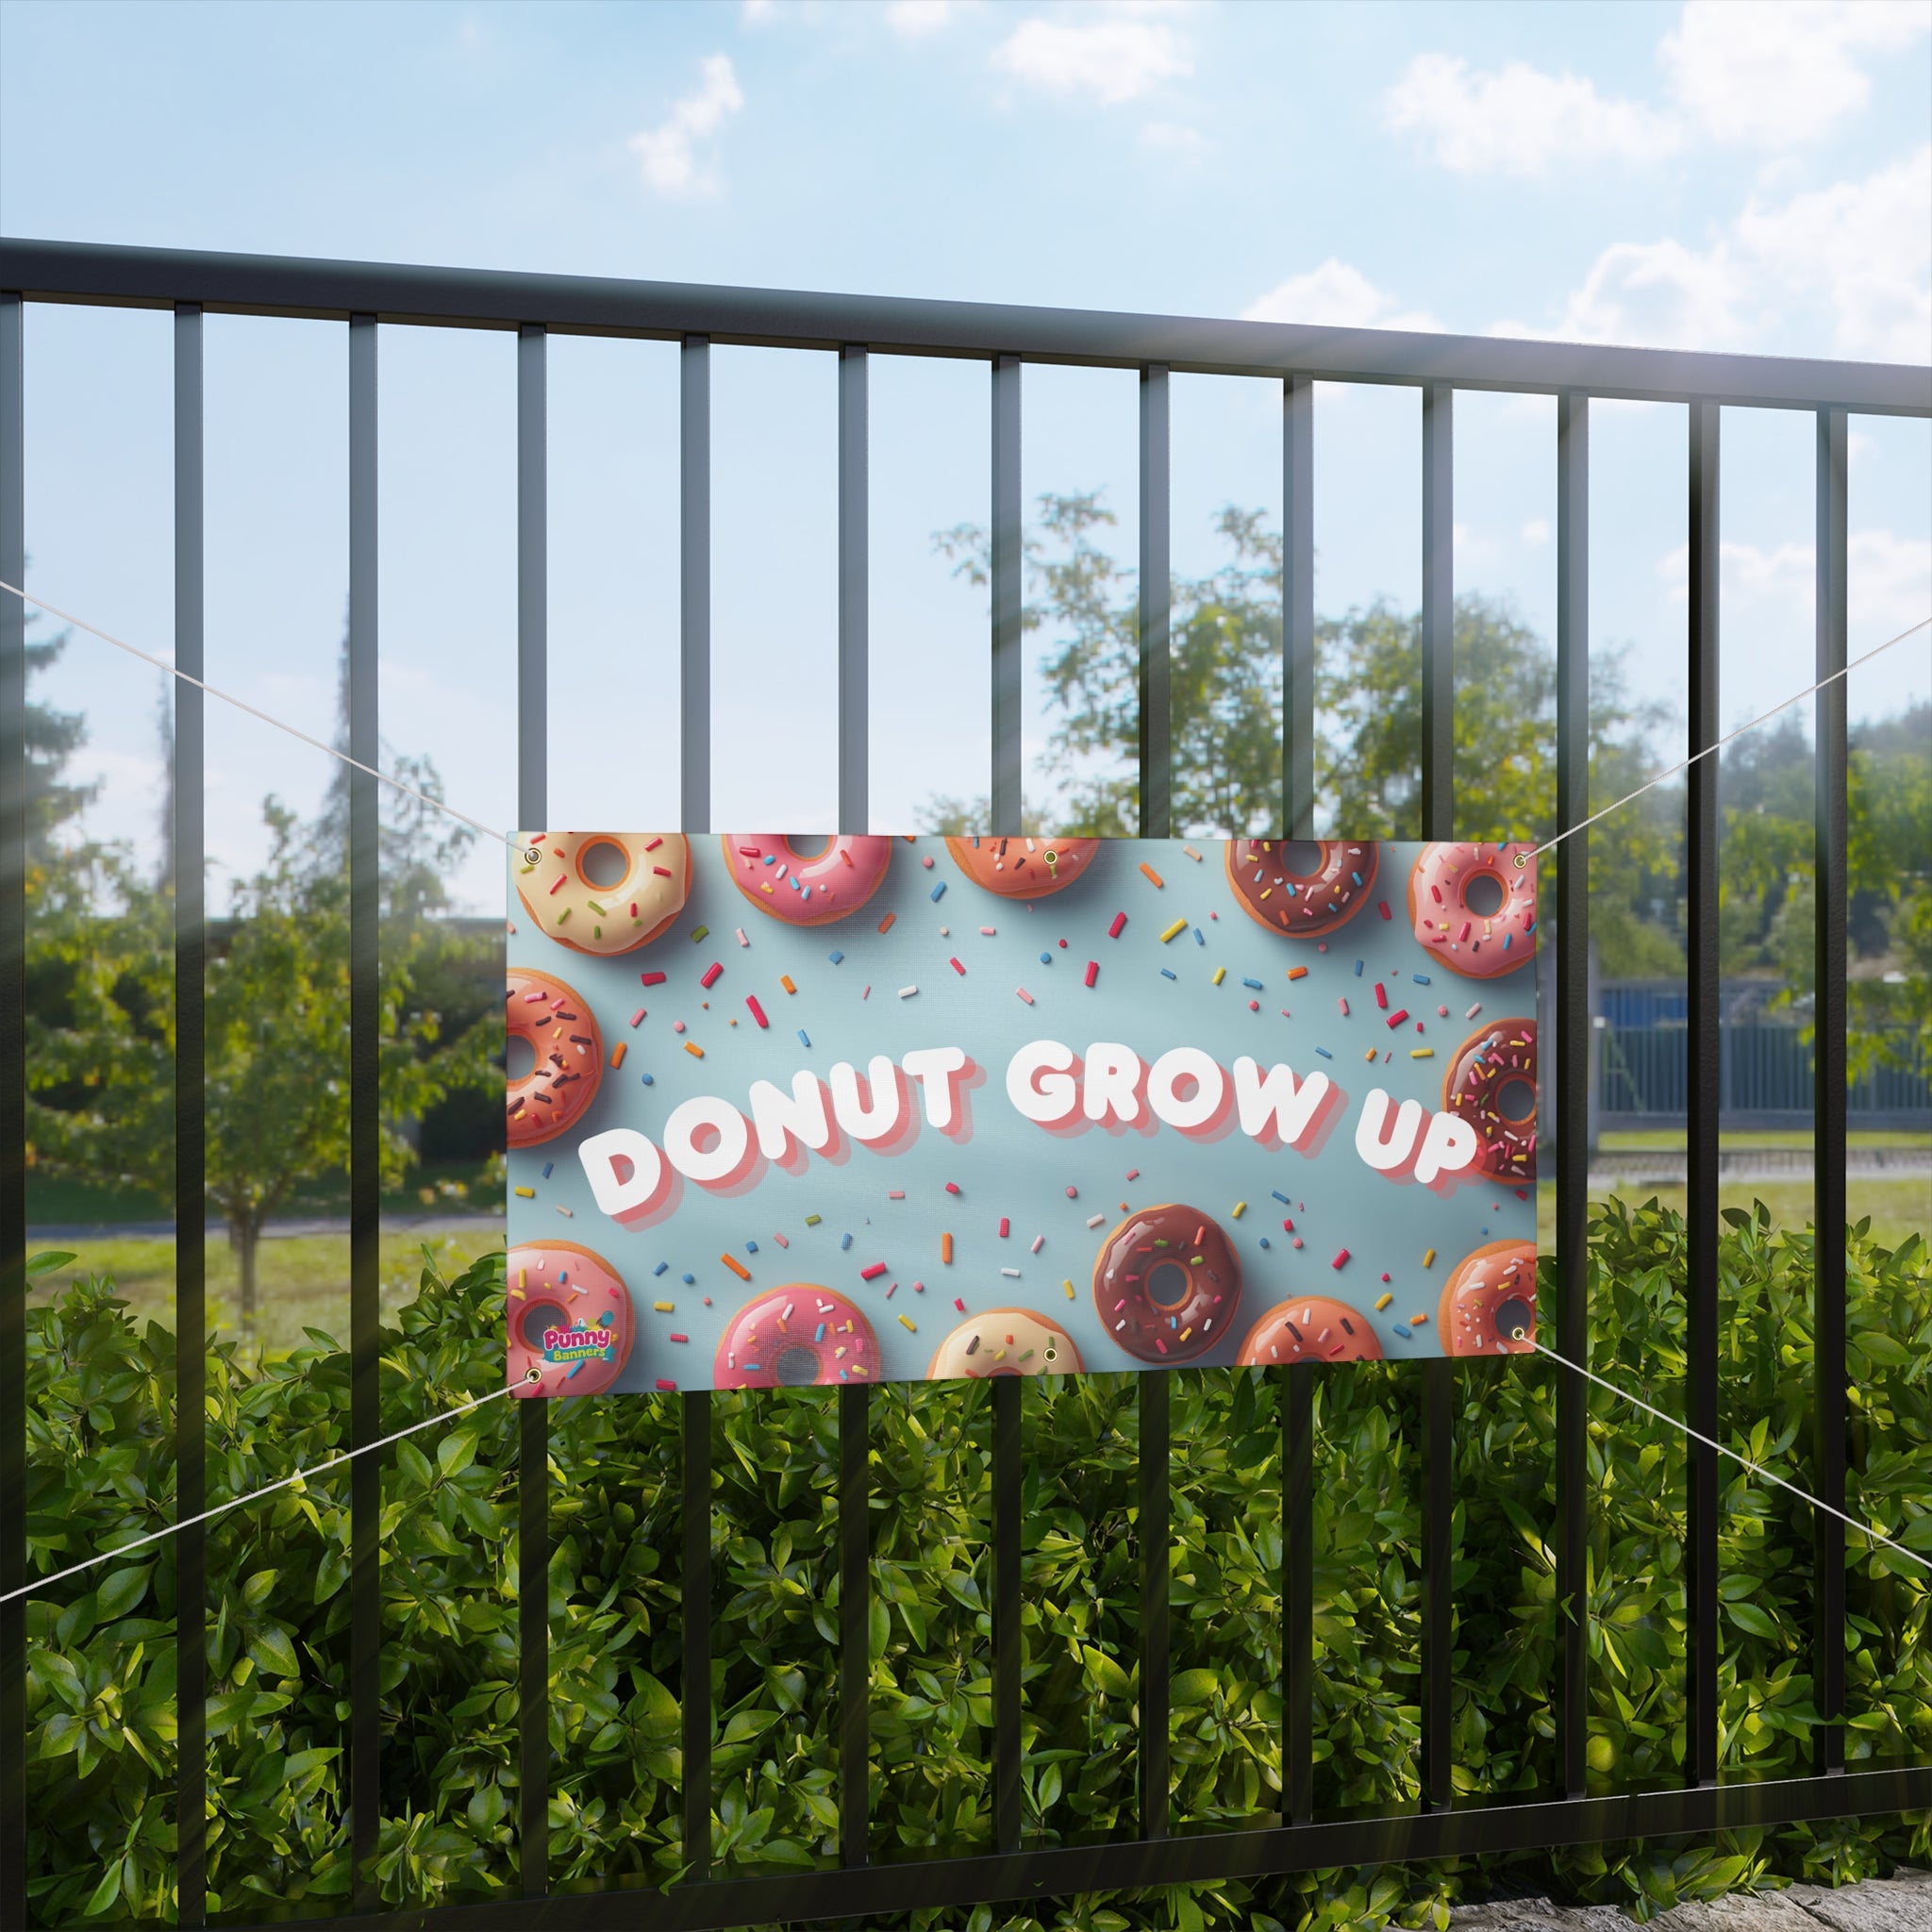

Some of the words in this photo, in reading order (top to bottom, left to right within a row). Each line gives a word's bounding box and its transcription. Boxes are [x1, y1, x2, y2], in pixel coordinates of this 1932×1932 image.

[578, 1046, 968, 1217] DONUT
[1006, 1040, 1330, 1144] GROW
[1356, 1088, 1479, 1185] UP
[543, 1329, 610, 1349] Punny
[553, 1349, 606, 1361] Banners
